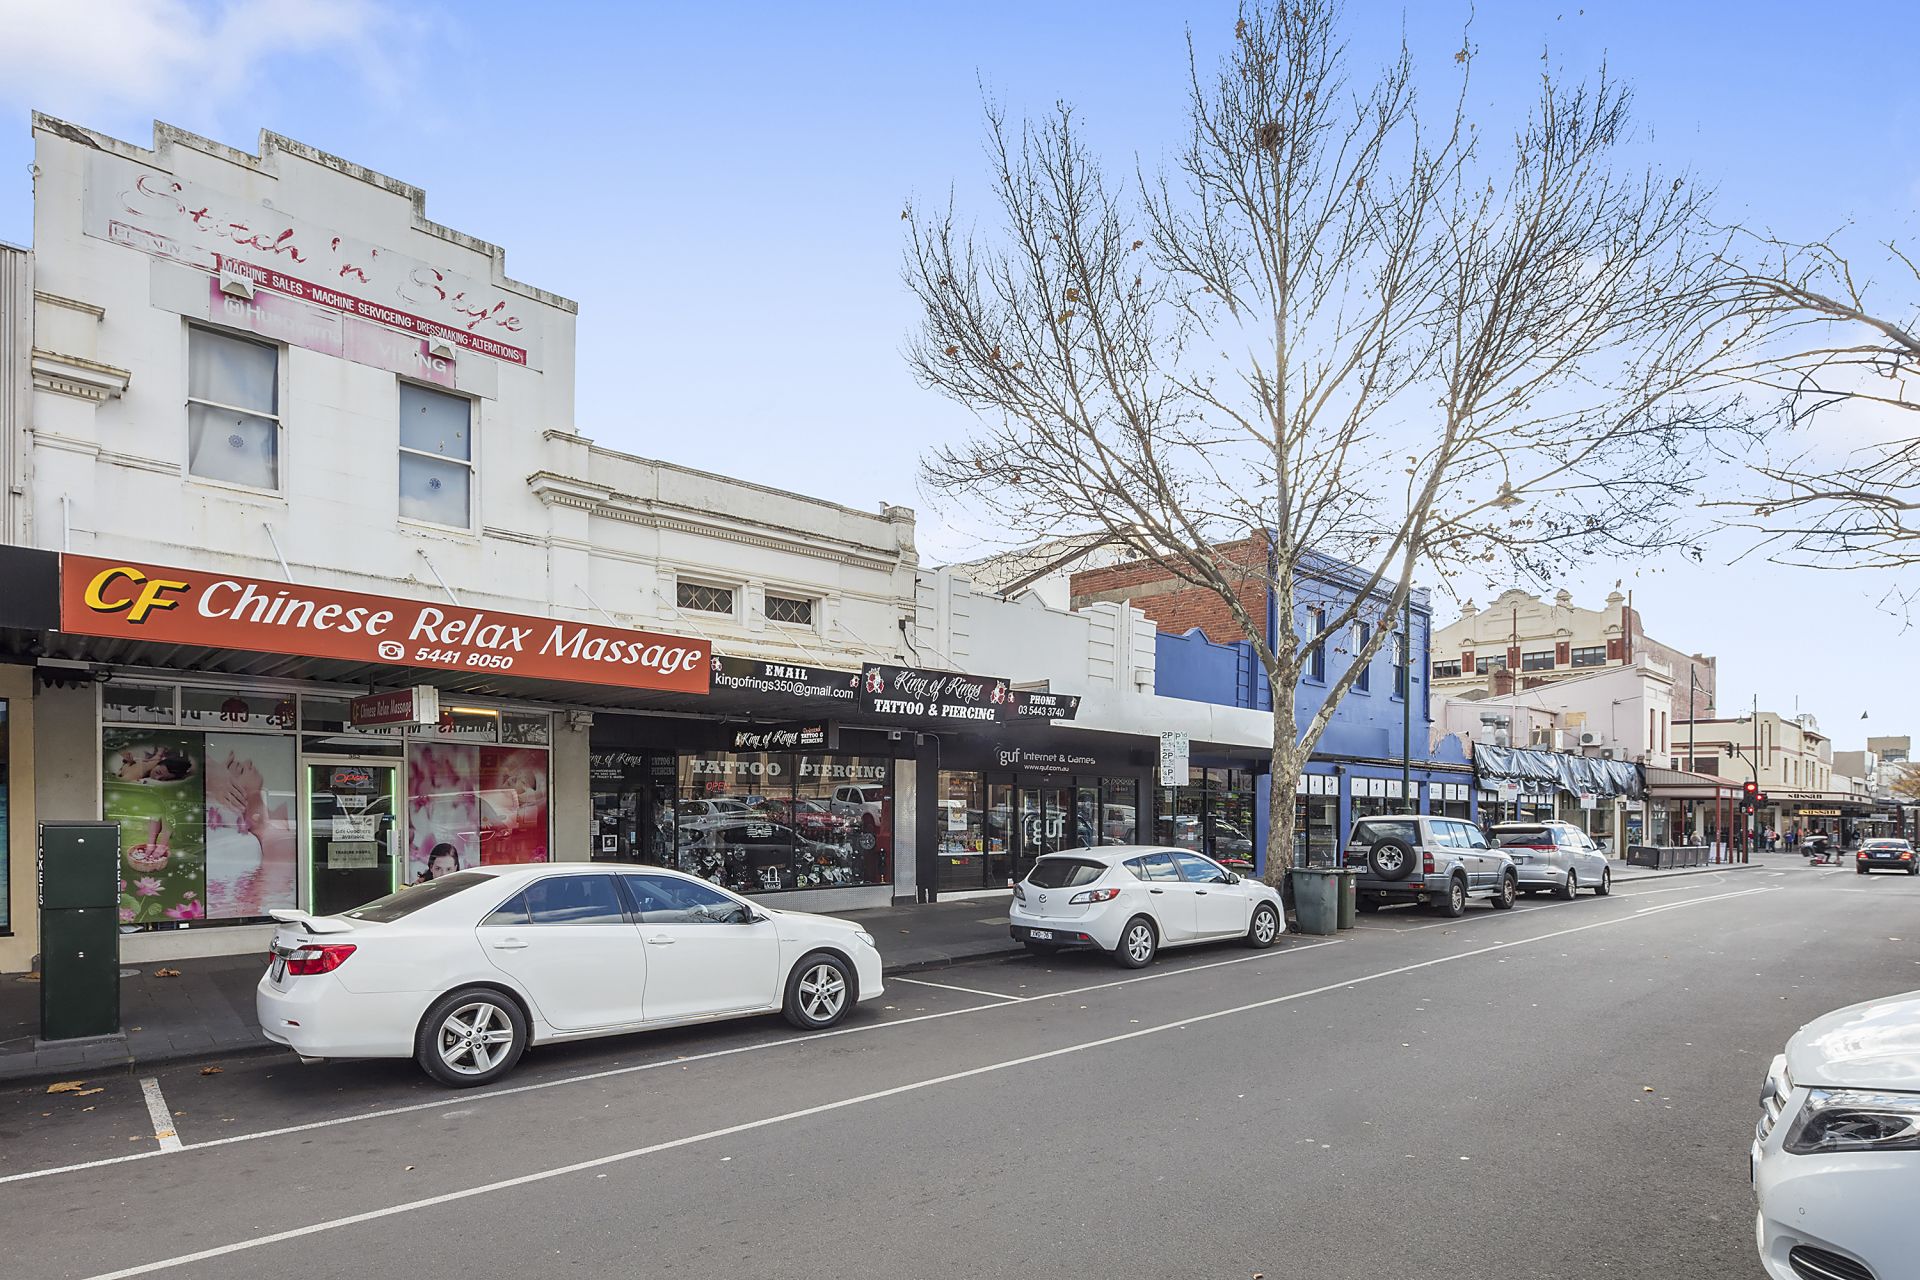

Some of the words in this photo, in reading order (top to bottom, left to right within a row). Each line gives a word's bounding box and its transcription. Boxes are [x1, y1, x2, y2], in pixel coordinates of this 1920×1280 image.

[222, 259, 268, 284] MACHINE
[272, 275, 303, 296] SALES
[312, 287, 354, 312] MACHINE
[358, 302, 412, 328] SERVICEING
[416, 320, 468, 346] DRESSMAKING
[472, 338, 520, 361] ALTERATIONS
[84, 566, 191, 624] CF
[197, 580, 394, 636] Chinese
[408, 607, 533, 652] Relax
[539, 624, 702, 675] Massage
[414, 647, 459, 664] 5441
[466, 652, 514, 670] 8050
[765, 664, 808, 680] EMAIL
[714, 672, 854, 699] kingofrings350@gmail.com
[894, 670, 931, 697] King
[929, 677, 945, 701] of
[945, 676, 983, 704] Rings
[361, 703, 376, 718] Chinese
[377, 700, 390, 716] Relax
[390, 699, 412, 717] Massage
[1029, 694, 1057, 706] PHONE
[873, 699, 925, 716] TATTOO
[927, 703, 938, 717] &
[941, 704, 996, 721] PIERCING
[1018, 706, 1028, 715] 03
[1029, 706, 1047, 717] 5443
[1048, 707, 1064, 718] 3740
[741, 732, 763, 749] King
[762, 731, 772, 748] of
[772, 730, 798, 749] Rings
[1000, 747, 1020, 766] guf
[1024, 751, 1057, 762] Internet
[1059, 754, 1066, 763] &
[1067, 754, 1096, 765] Games
[690, 759, 781, 776] TATTOO
[799, 763, 886, 779] PIERCING
[1024, 764, 1070, 772] www.guf.com.au
